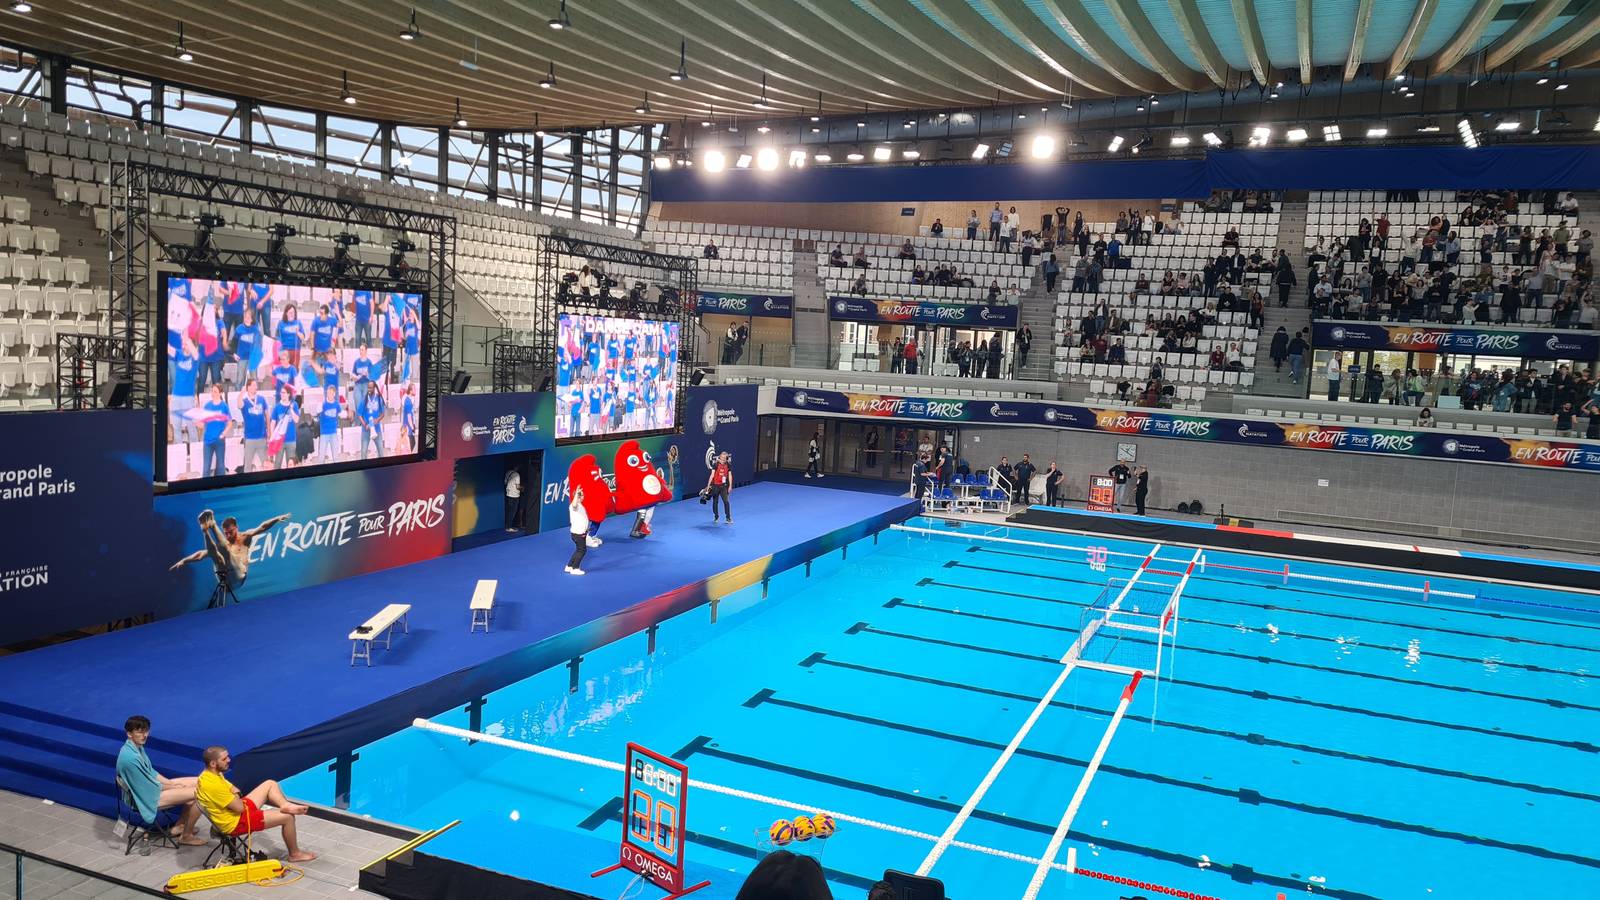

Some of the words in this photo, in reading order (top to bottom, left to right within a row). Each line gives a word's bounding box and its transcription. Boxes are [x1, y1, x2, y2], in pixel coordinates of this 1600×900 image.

[718, 297, 747, 310] PARIS
[880, 305, 891, 315] EN
[893, 305, 921, 316] ROUTE
[936, 307, 965, 319] PARIS
[1393, 331, 1410, 344] EN
[1411, 330, 1452, 346] ROUTE
[1456, 335, 1473, 345] POUR
[1476, 333, 1520, 350] PARIS
[853, 399, 868, 411] EN
[869, 399, 909, 414] ROUTE
[909, 403, 924, 412] POUR
[926, 402, 963, 418] PARIS
[1100, 416, 1115, 428] EN
[1115, 415, 1153, 431] ROUTE
[1155, 419, 1170, 429] POUR
[1171, 419, 1210, 436] PARIS
[492, 427, 515, 444] PARIS
[1288, 431, 1308, 443] EN
[1306, 430, 1349, 446] ROUTE
[1351, 435, 1369, 446] POUR
[1369, 433, 1415, 451] PARIS
[1515, 447, 1535, 460] EN
[1535, 447, 1585, 464] ROUTE
[38, 479, 76, 496] Paris
[544, 482, 561, 505] EN
[248, 531, 280, 563] EN
[281, 511, 358, 558] ROUTE
[359, 515, 384, 534] POUR
[387, 494, 446, 538] PARIS
[5, 565, 49, 577] FRANÇAISE
[634, 853, 674, 884] OMEGA
[185, 873, 244, 889] RESCUE
